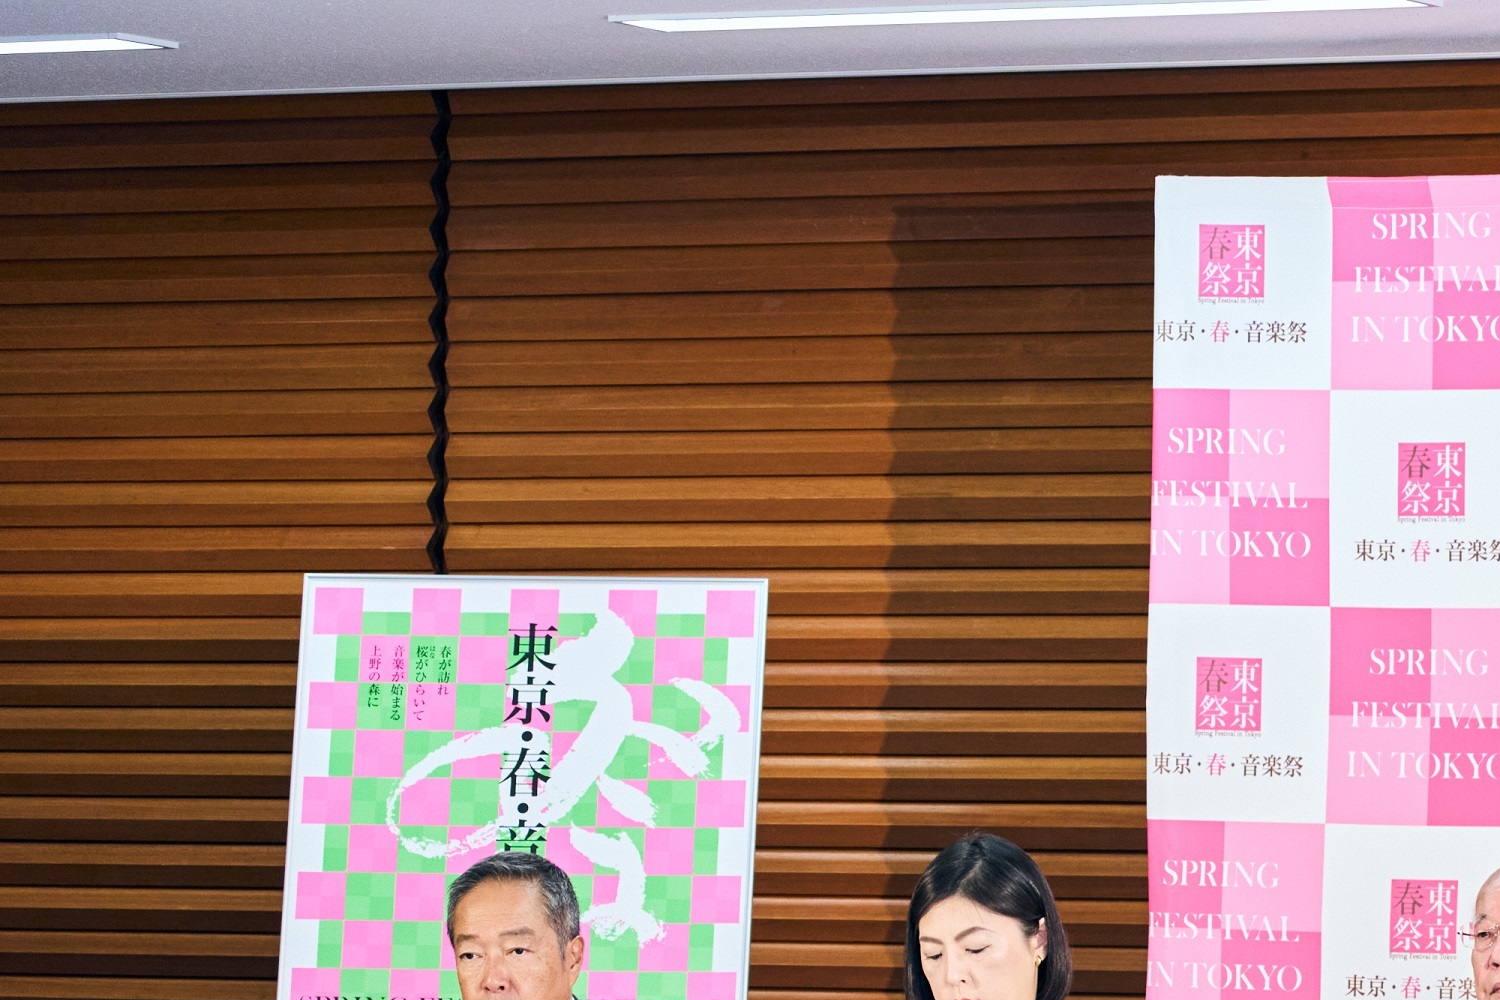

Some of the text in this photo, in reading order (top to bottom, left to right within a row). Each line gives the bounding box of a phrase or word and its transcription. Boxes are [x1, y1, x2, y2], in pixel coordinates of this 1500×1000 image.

[1372, 211, 1492, 240] SPRING
[1155, 318, 1308, 345] 東京・春・音楽祭
[1351, 315, 1386, 343] IN
[1167, 427, 1286, 456] SPRING
[1152, 480, 1307, 510] FESTIVAL
[1150, 528, 1311, 558] IN TOKYO
[367, 645, 382, 708] 上野の森に
[437, 645, 452, 696] 春が訪れ
[1370, 648, 1489, 676] SPRING
[390, 645, 405, 721] 音楽が始まる
[413, 645, 429, 721] 桜がひらいて
[1152, 751, 1304, 779] 東京・春・音楽祭
[1347, 750, 1382, 778] IN
[1162, 859, 1279, 889] SPRING
[1149, 911, 1300, 942] FESTIVAL
[1147, 960, 1302, 991] IN TOKYO
